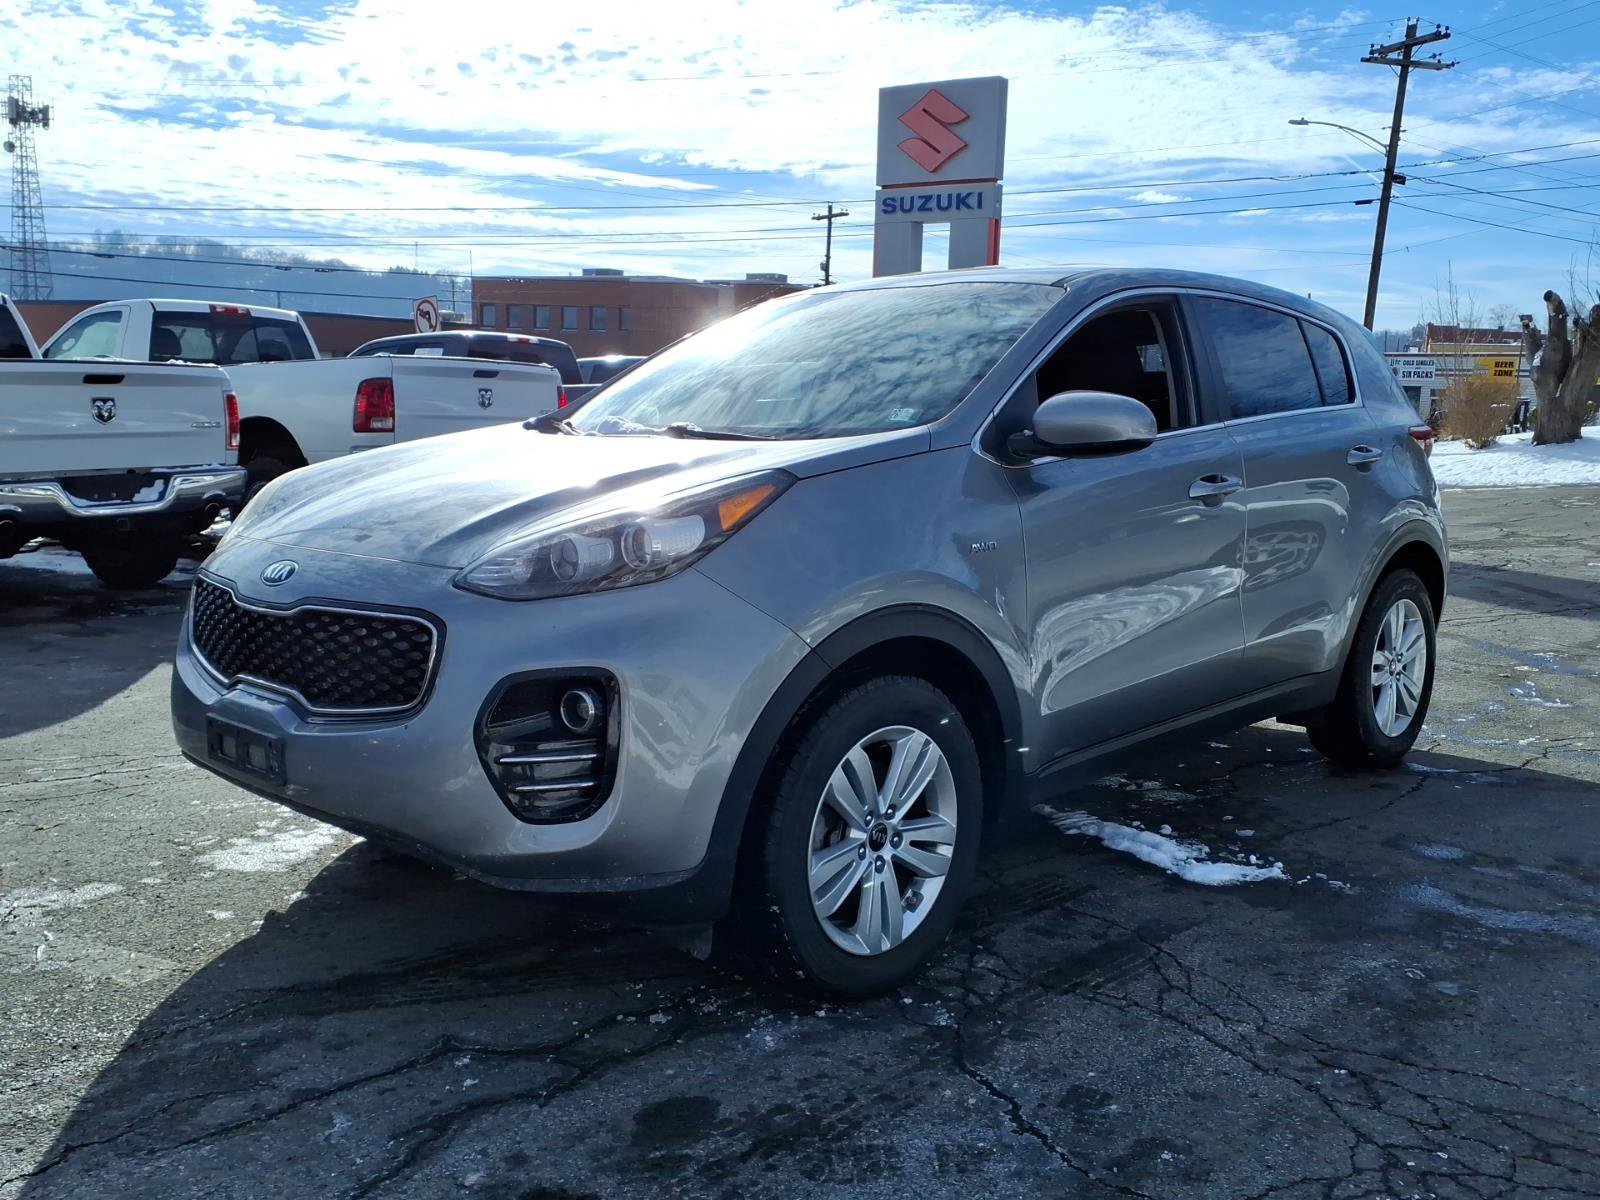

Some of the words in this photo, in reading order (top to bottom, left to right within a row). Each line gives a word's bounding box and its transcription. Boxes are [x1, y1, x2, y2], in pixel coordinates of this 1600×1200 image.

[881, 191, 984, 215] SUZUKI
[1402, 370, 1412, 378] SIX
[1413, 370, 1434, 378] PACKS
[1493, 369, 1514, 377] ZONE
[969, 541, 997, 553] AWD
[262, 562, 293, 581] KIA
